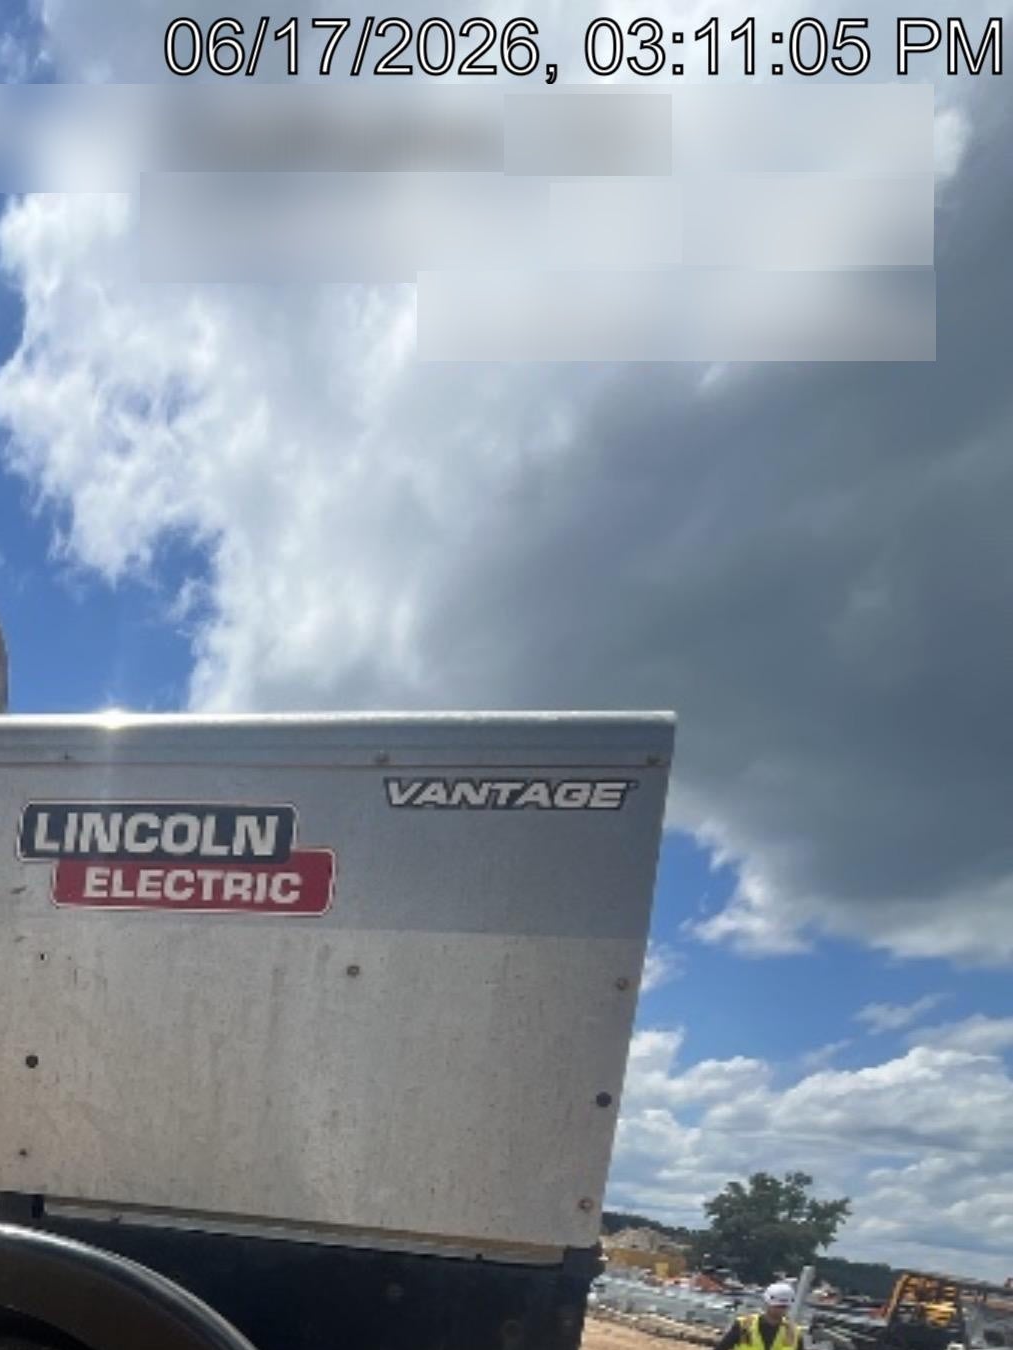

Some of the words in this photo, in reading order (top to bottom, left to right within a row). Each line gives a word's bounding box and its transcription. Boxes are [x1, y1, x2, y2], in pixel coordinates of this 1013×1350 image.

[386, 779, 628, 809] VANTAGE
[33, 811, 279, 857] LINCOLN
[82, 865, 303, 905] ELECTRIC
